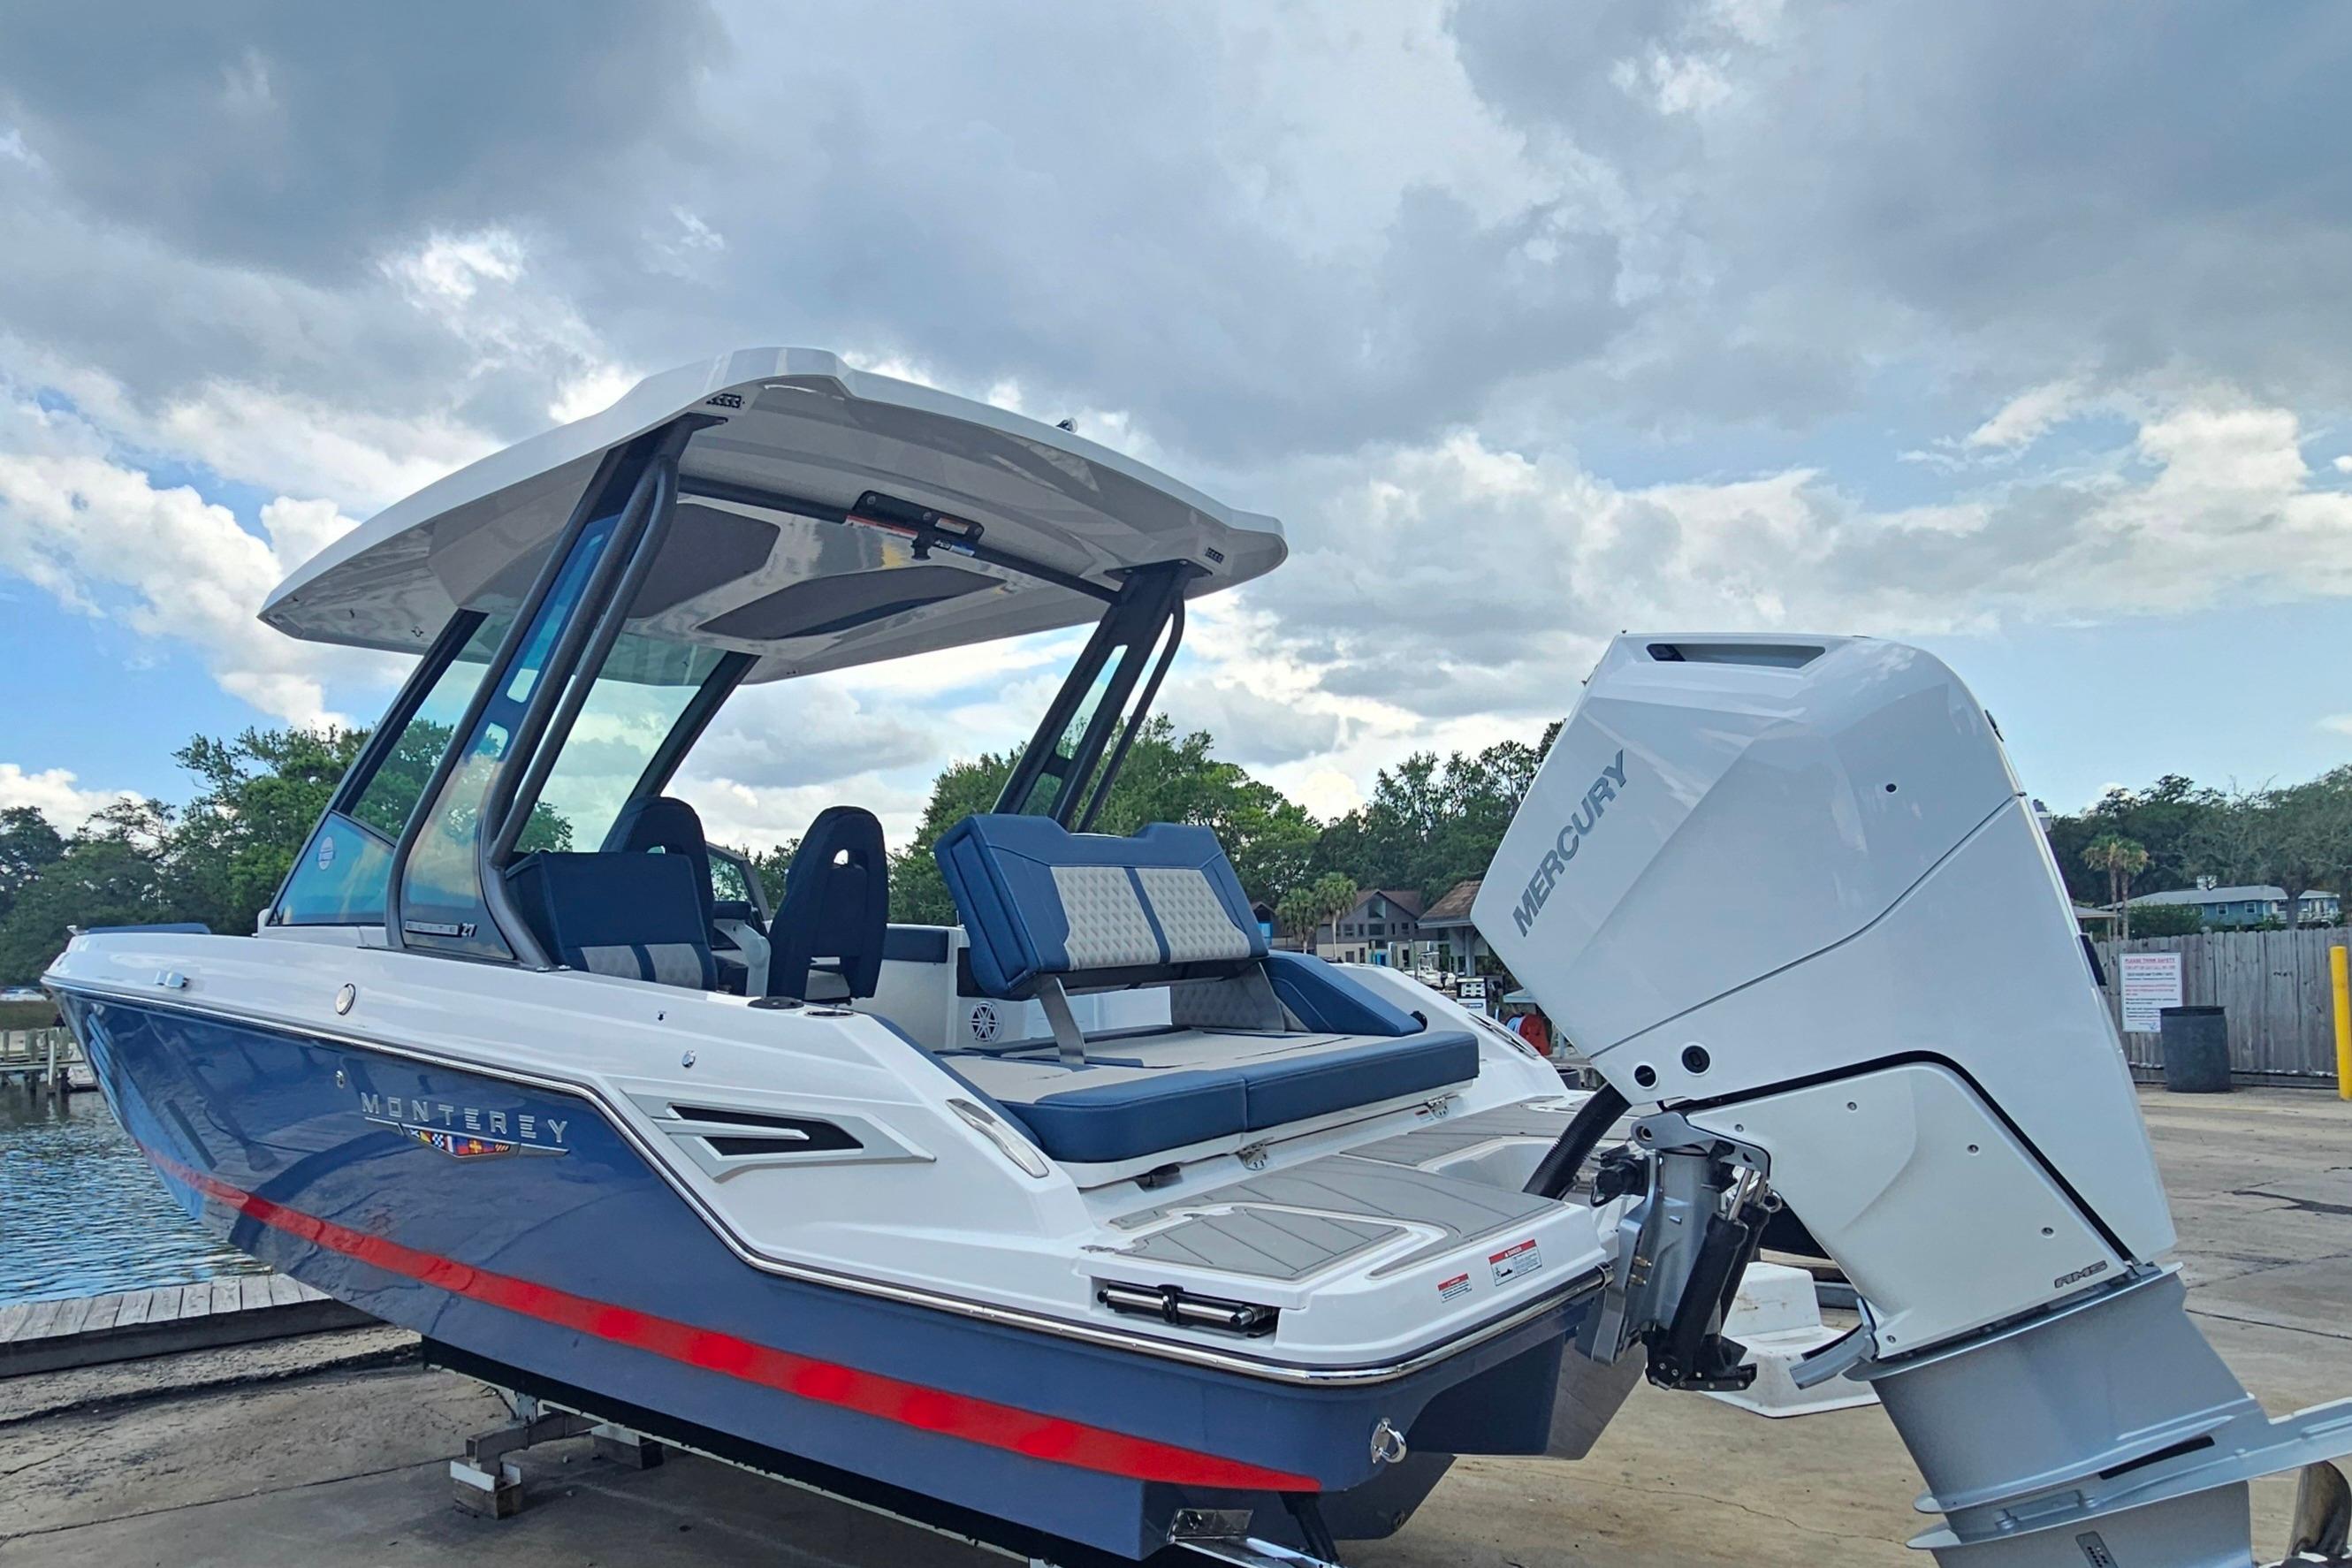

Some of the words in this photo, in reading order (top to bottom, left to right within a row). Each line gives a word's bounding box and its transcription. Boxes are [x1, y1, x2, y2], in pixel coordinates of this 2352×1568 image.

[1512, 749, 1627, 938] MERCURY
[407, 922, 456, 933] ELITE
[461, 923, 477, 938] 27
[360, 1092, 567, 1144] MONTEREY
[2054, 1260, 2108, 1289] AMS
